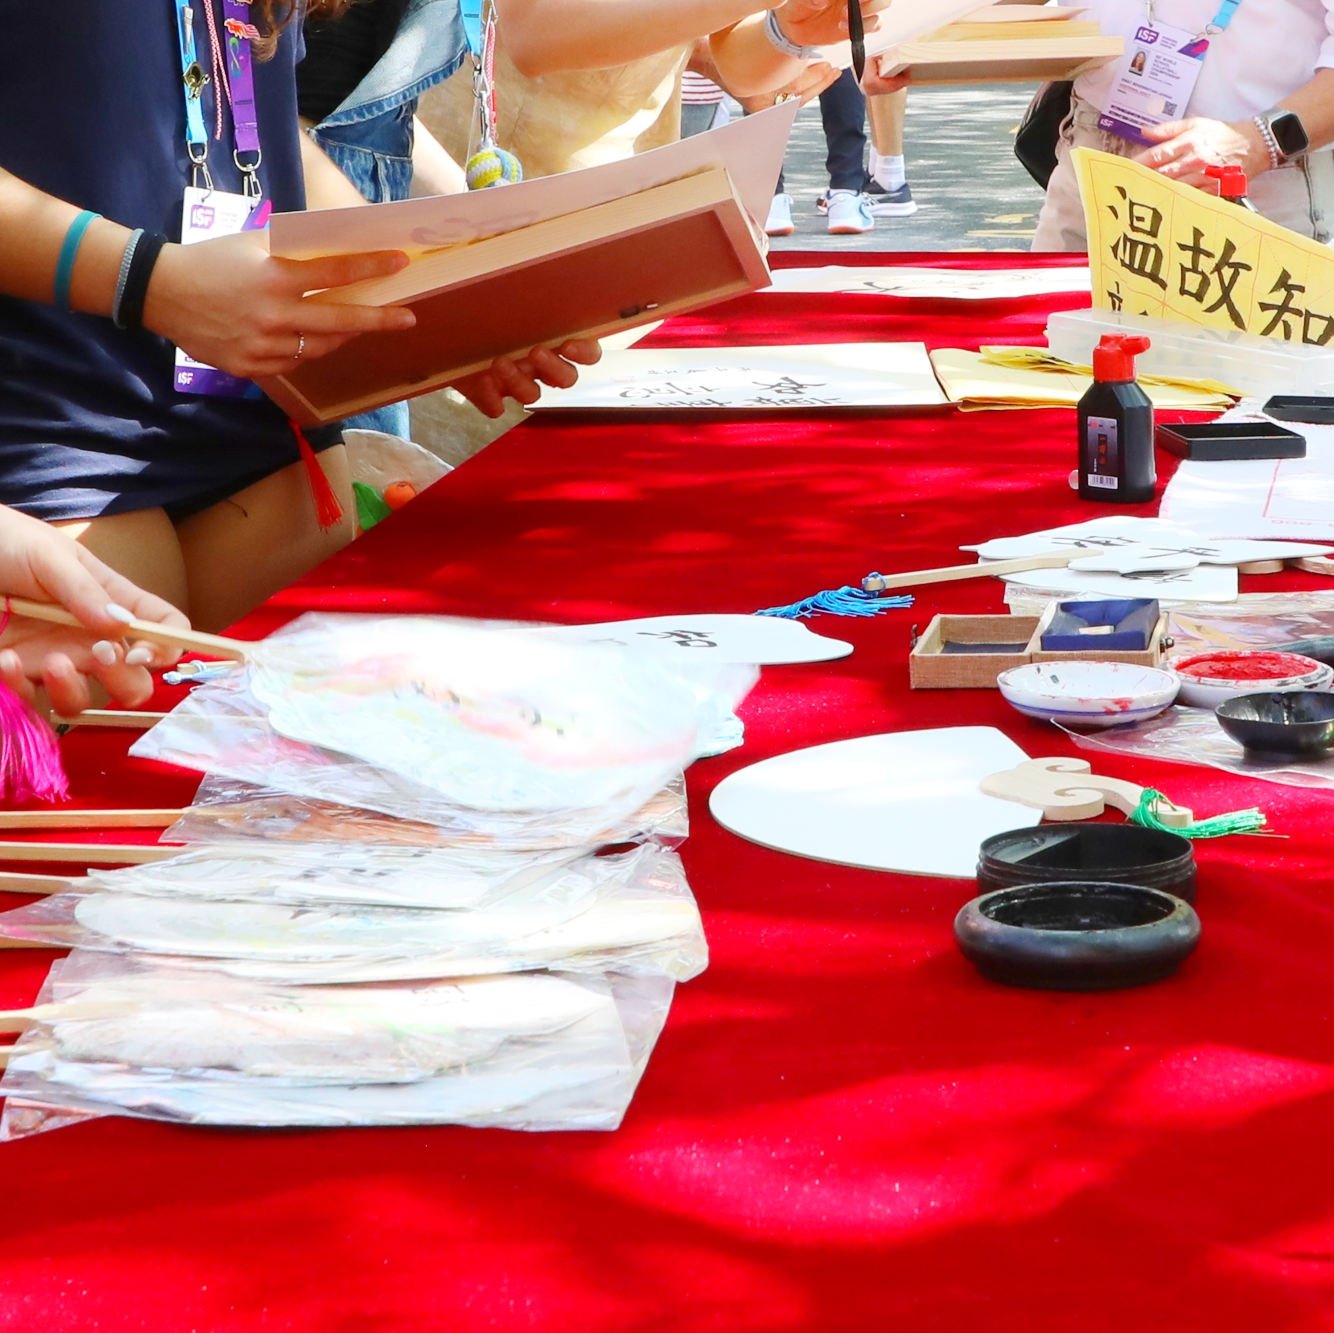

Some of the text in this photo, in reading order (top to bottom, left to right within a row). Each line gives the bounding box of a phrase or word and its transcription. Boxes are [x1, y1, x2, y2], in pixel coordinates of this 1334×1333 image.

[1137, 27, 1158, 44] ISF
[1100, 118, 1114, 127] ISF
[192, 207, 213, 227] ISF
[177, 372, 195, 385] ISF
